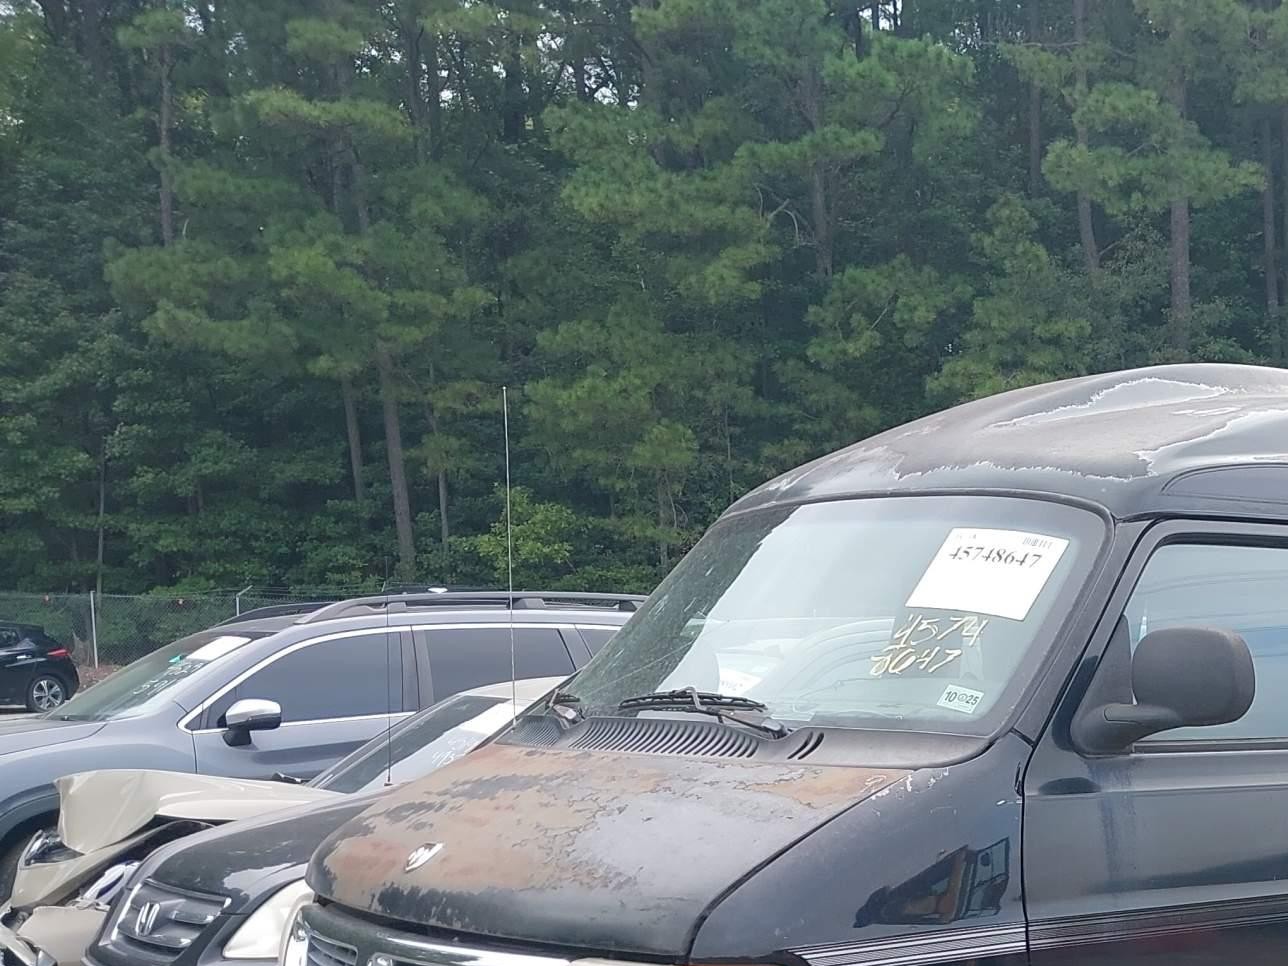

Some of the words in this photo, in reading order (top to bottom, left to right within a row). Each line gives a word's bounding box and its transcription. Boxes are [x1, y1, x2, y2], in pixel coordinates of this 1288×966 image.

[949, 546, 1042, 568] 45748647
[894, 614, 989, 646] 4574
[944, 691, 957, 702] 10
